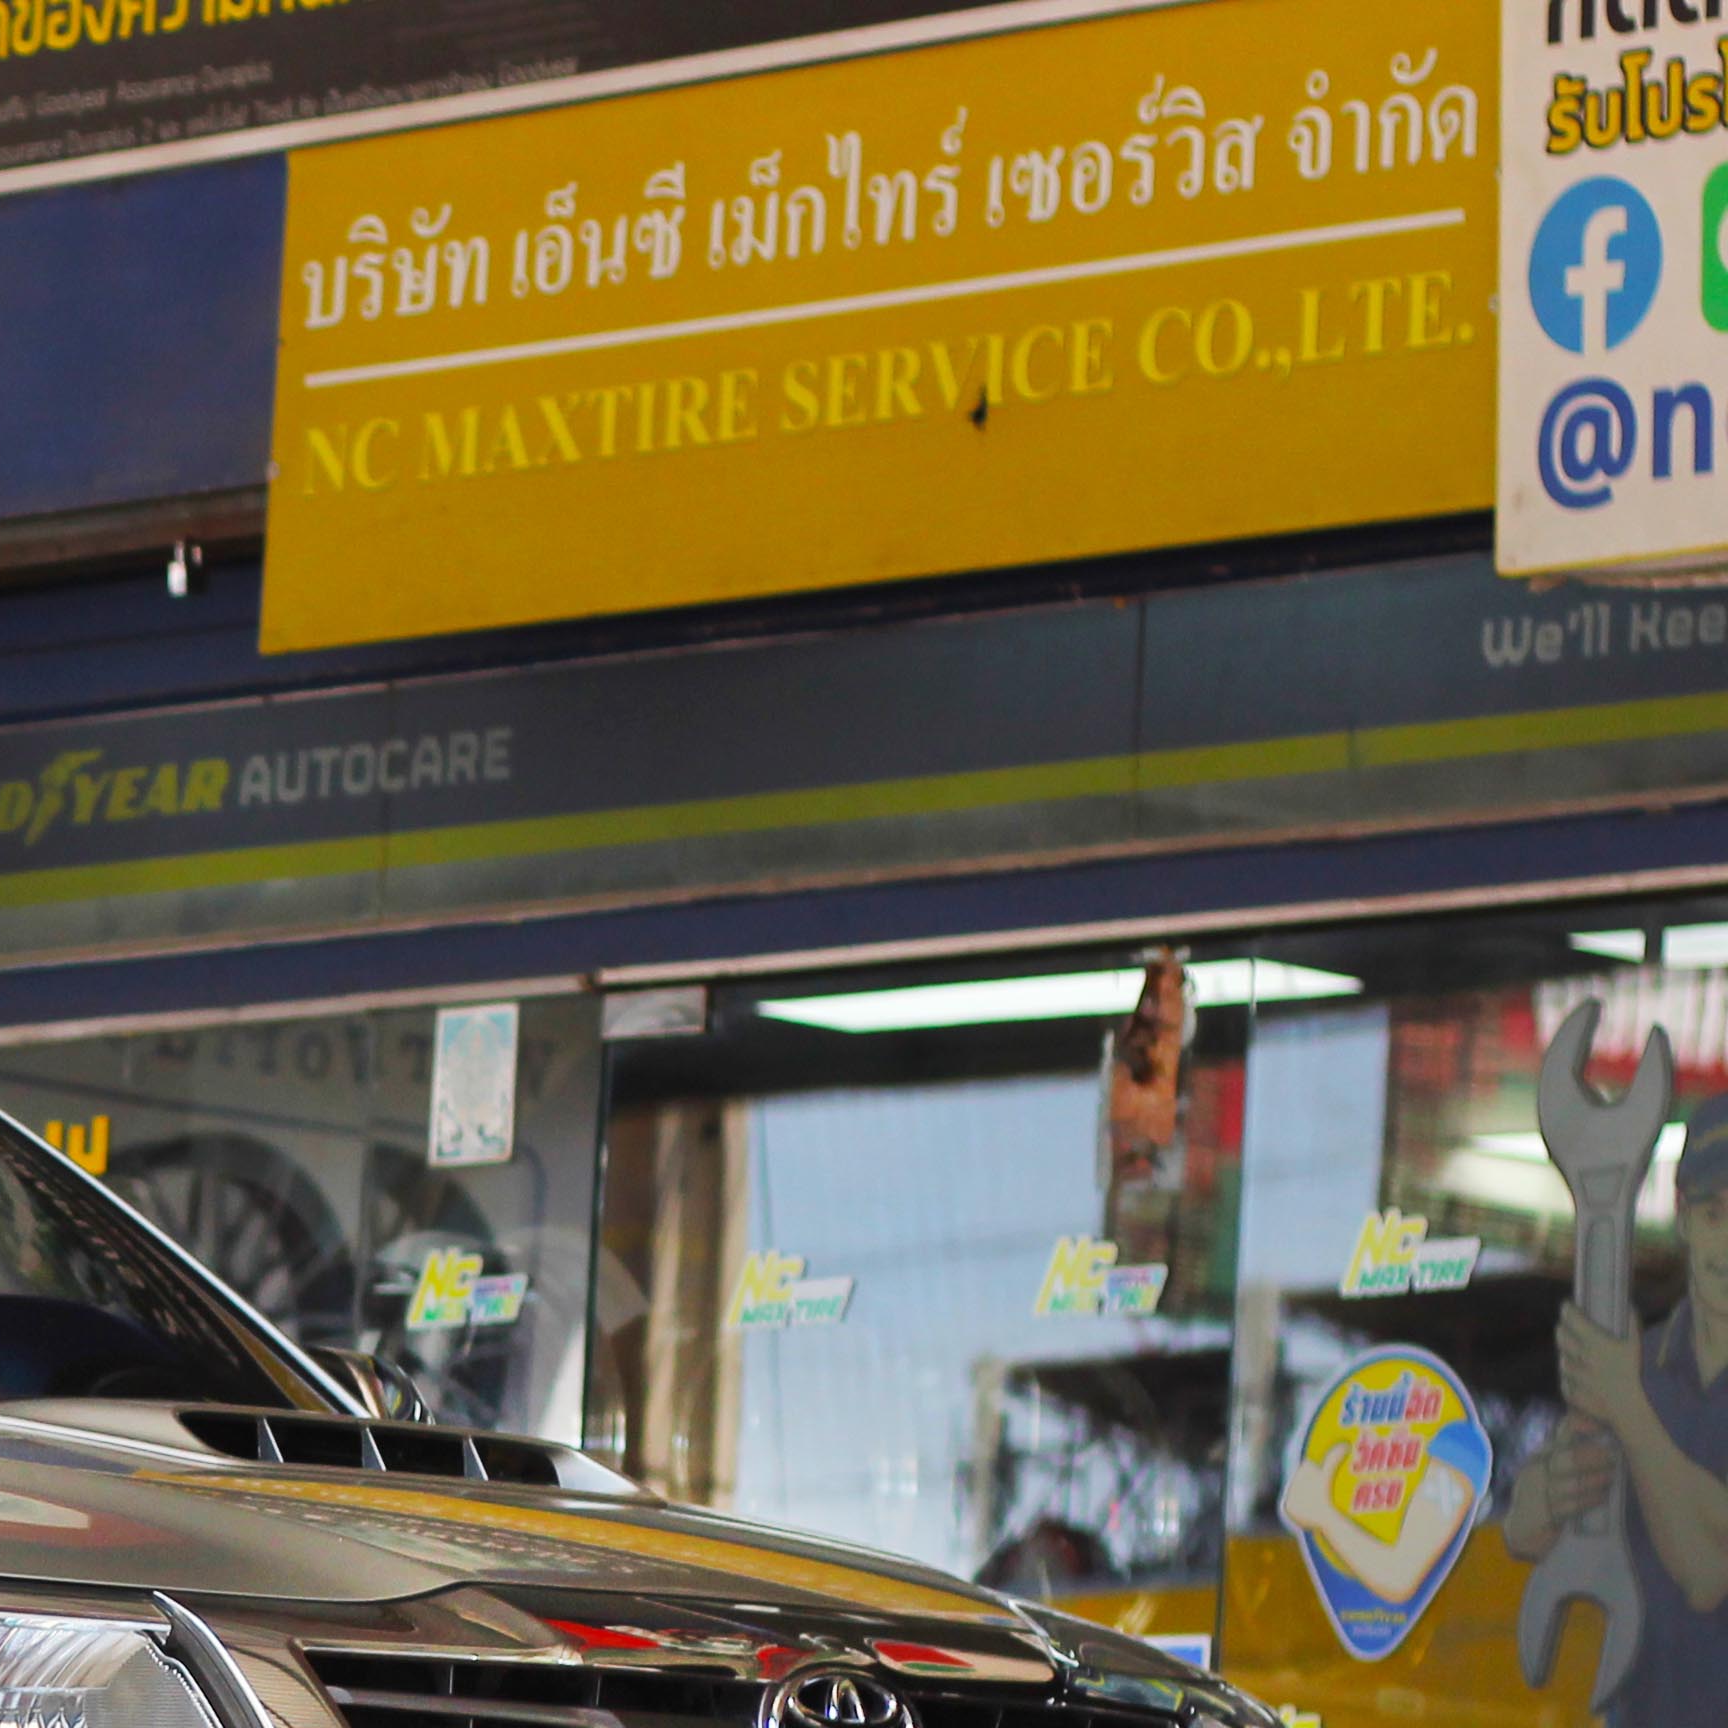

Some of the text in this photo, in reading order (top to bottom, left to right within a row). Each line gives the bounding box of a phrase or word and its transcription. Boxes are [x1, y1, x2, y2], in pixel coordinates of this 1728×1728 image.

[1546, 36, 1728, 154] รับโปร
[302, 47, 1479, 329] บริษัท เอ็นซี เม็กไทร์ เซอร์วิส จำกัด
[302, 417, 400, 497] NC
[417, 366, 759, 481] MAXTIRE
[779, 317, 1114, 435] SERVICE
[1537, 376, 1728, 509] @n
[1482, 601, 1611, 668] We'll
[238, 727, 513, 806] AUTOCARE
